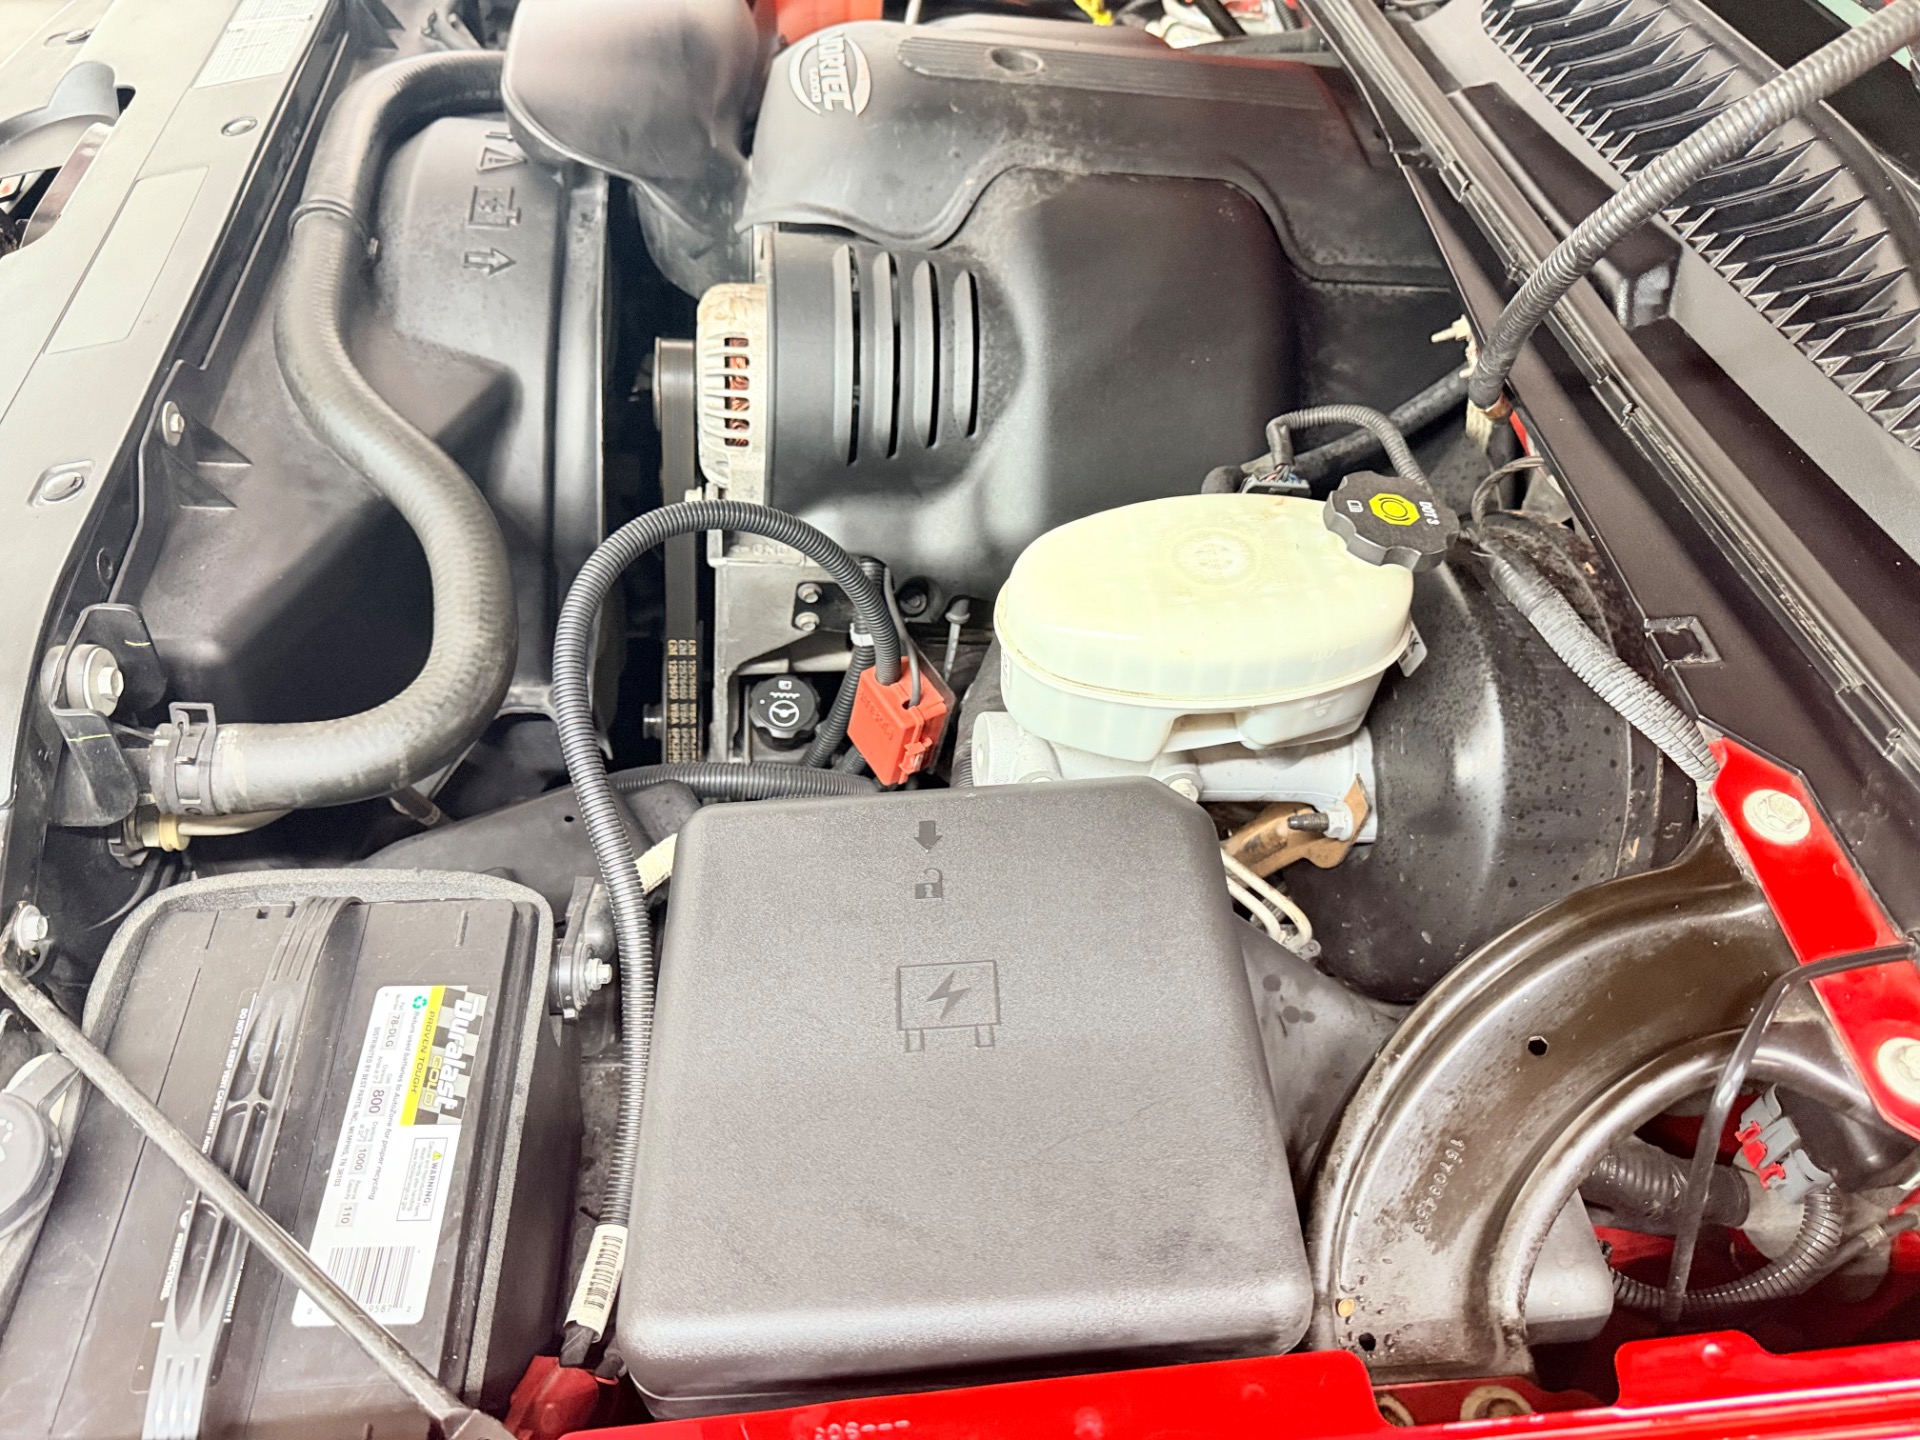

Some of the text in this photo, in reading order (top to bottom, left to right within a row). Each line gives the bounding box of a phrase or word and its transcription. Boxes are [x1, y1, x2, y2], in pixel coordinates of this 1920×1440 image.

[818, 32, 855, 111] VORTEC
[1418, 501, 1437, 520] DOT
[239, 1007, 248, 1019] DO
[234, 1019, 245, 1034] NOT
[384, 1014, 400, 1047] 78-DLG
[365, 1026, 380, 1063] DISTRIBUTED
[410, 1010, 435, 1091] PROVEN TOUGH
[434, 997, 480, 1110] Duralast
[225, 1048, 236, 1068] KEEP
[219, 1069, 231, 1088] VENT
[359, 1073, 368, 1088] BEST
[423, 1054, 442, 1107] GOLD
[367, 1010, 420, 1200] Return used batteries to AutoZone for proper recycling
[368, 1089, 384, 1113] 800
[339, 1157, 347, 1166] TN
[353, 1148, 367, 1170] 1000
[333, 1167, 344, 1186] 38103
[422, 1162, 438, 1206] WARNING:
[340, 1206, 352, 1223] 110
